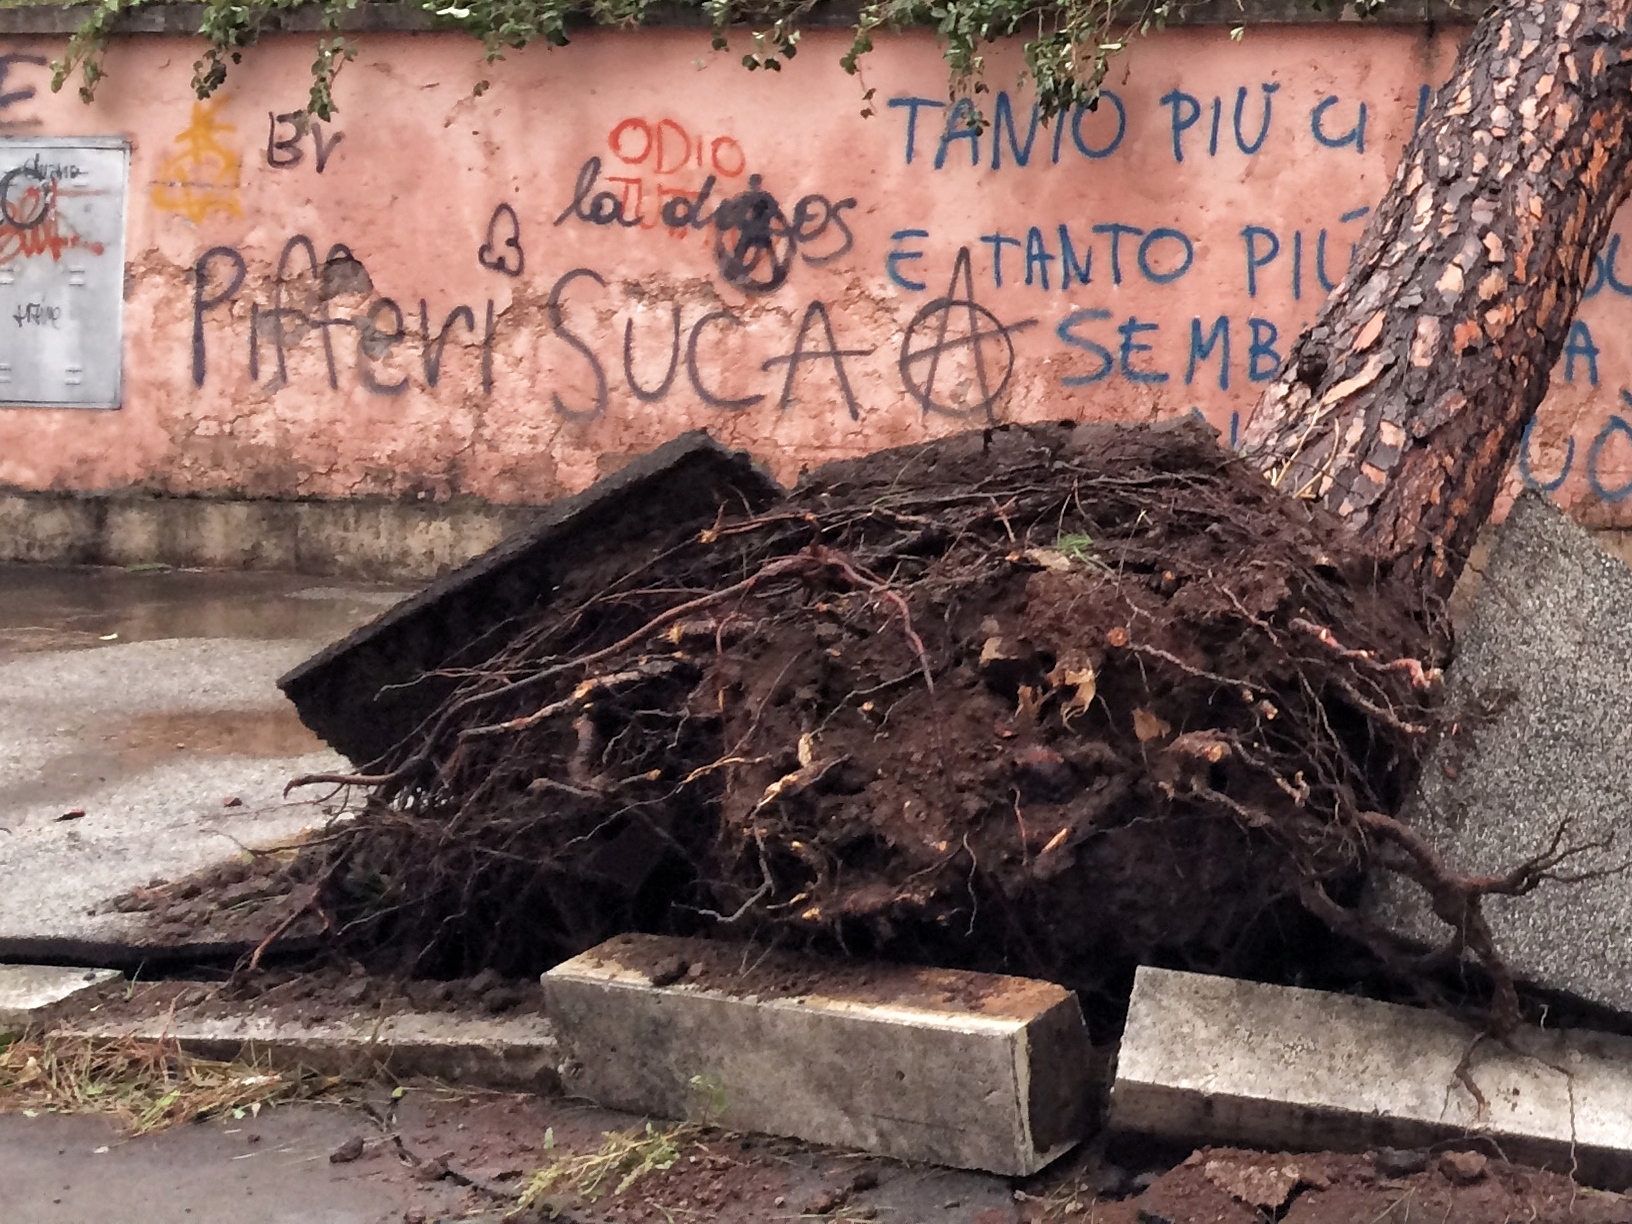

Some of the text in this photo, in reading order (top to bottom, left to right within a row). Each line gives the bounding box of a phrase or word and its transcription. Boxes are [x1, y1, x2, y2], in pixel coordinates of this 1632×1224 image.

[608, 117, 746, 177] ODIO
[982, 224, 1195, 290] TANTO
[550, 268, 876, 421] SUCA
[1055, 307, 1284, 390] SEMB
